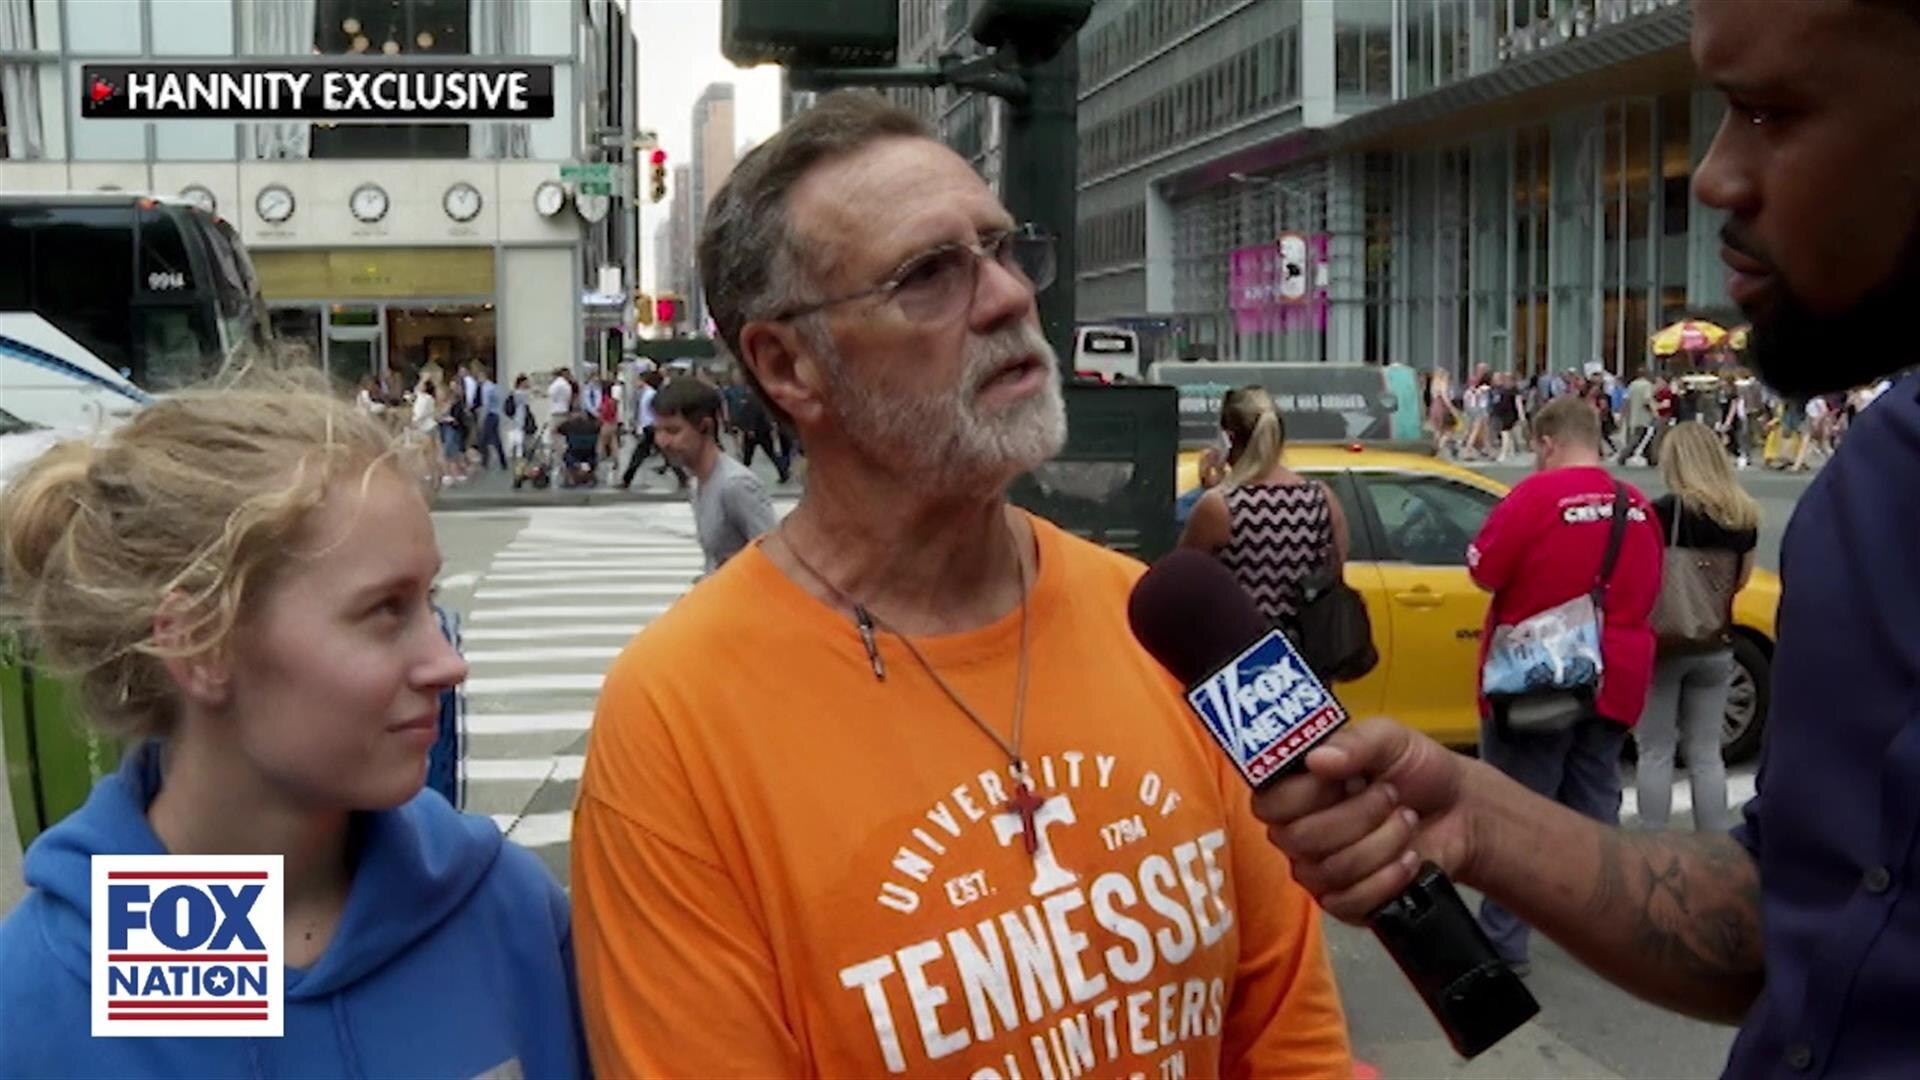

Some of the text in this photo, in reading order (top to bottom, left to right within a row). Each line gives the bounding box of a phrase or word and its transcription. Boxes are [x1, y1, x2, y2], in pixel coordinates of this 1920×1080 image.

[1236, 656, 1304, 716] FOX
[1240, 682, 1321, 753] NEWS
[878, 751, 1182, 915] UNIVERSITY OF
[990, 793, 1079, 898] T
[1100, 814, 1148, 851] 1794
[944, 868, 998, 908] EST.
[839, 828, 1234, 1074] TENNESSEE
